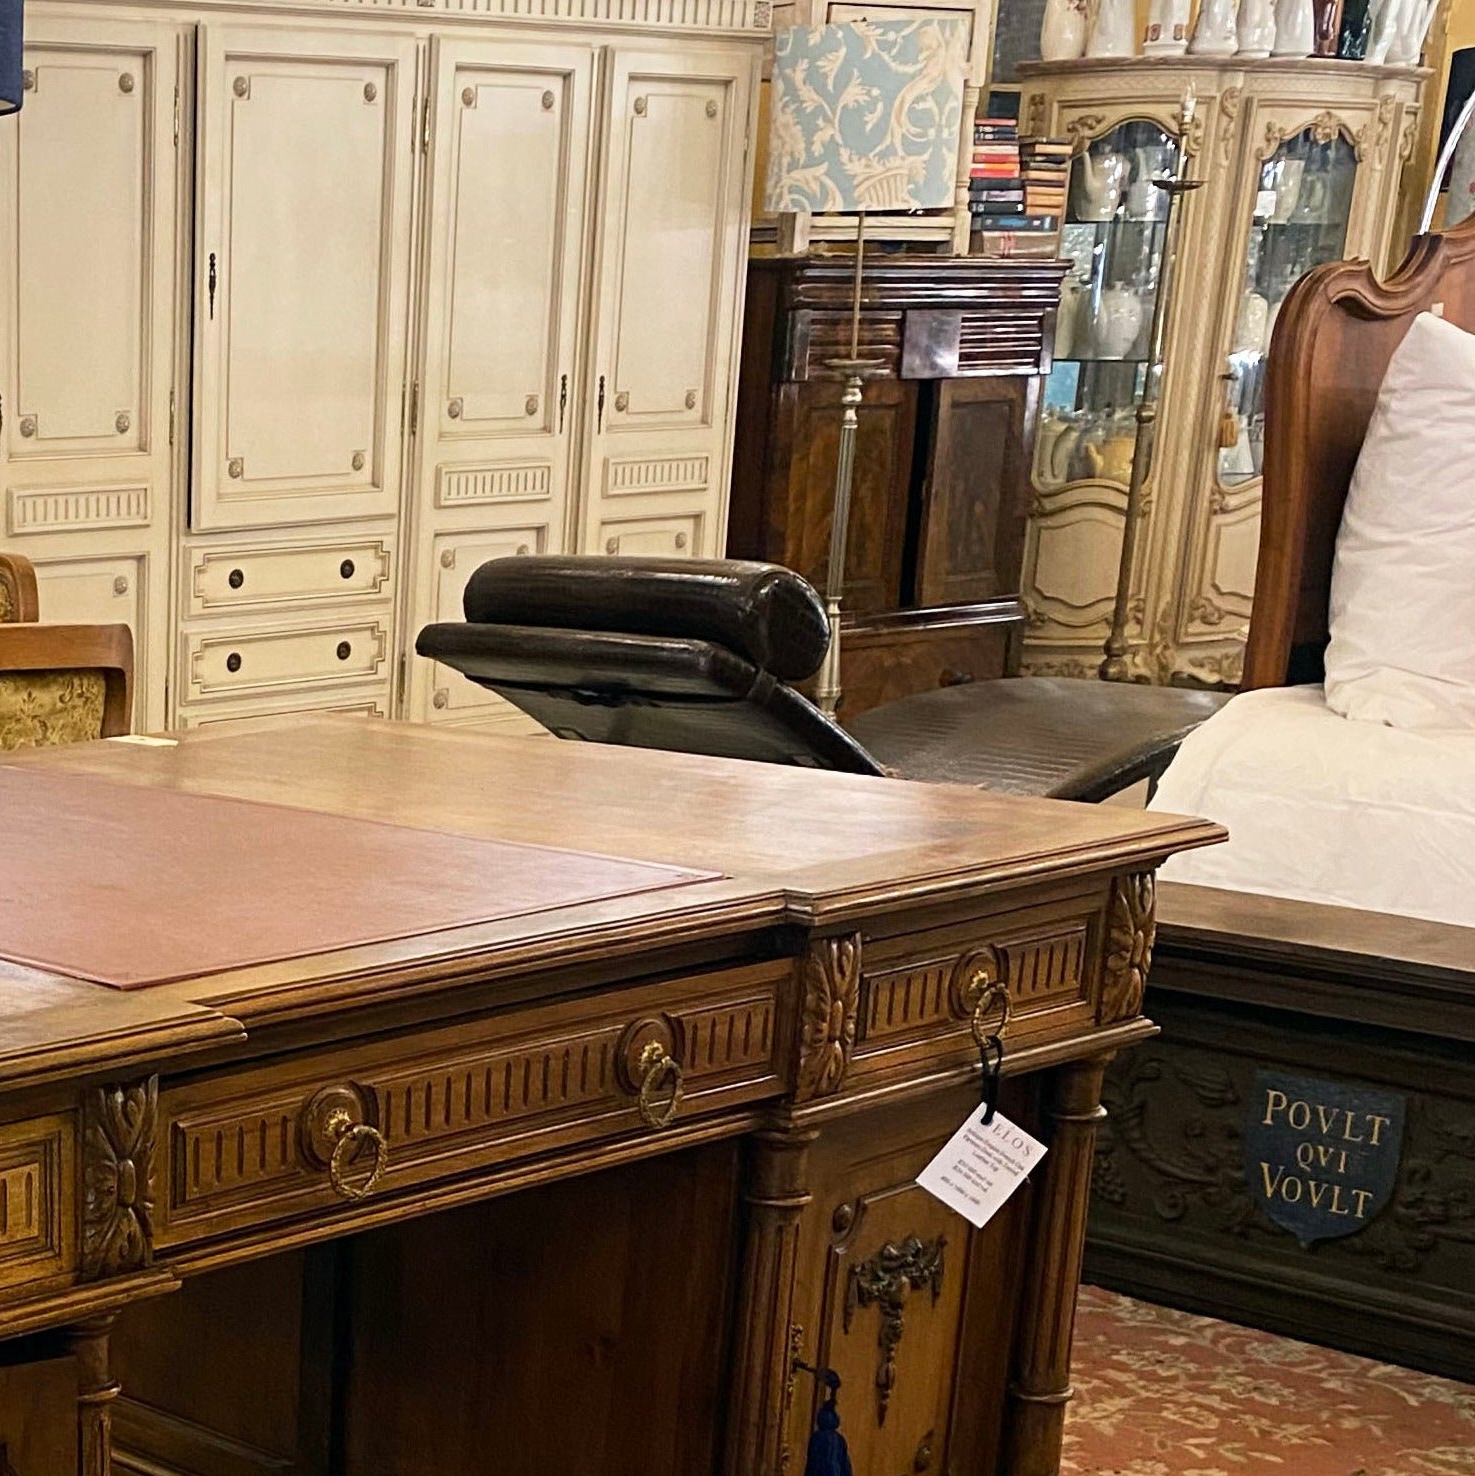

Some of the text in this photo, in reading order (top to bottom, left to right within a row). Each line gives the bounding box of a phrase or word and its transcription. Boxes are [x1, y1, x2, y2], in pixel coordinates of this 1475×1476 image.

[990, 1121, 1034, 1157] ELOS
[1262, 1088, 1391, 1147] POVLT
[1296, 1142, 1348, 1174] QVI
[1259, 1161, 1374, 1219] VOVLT
